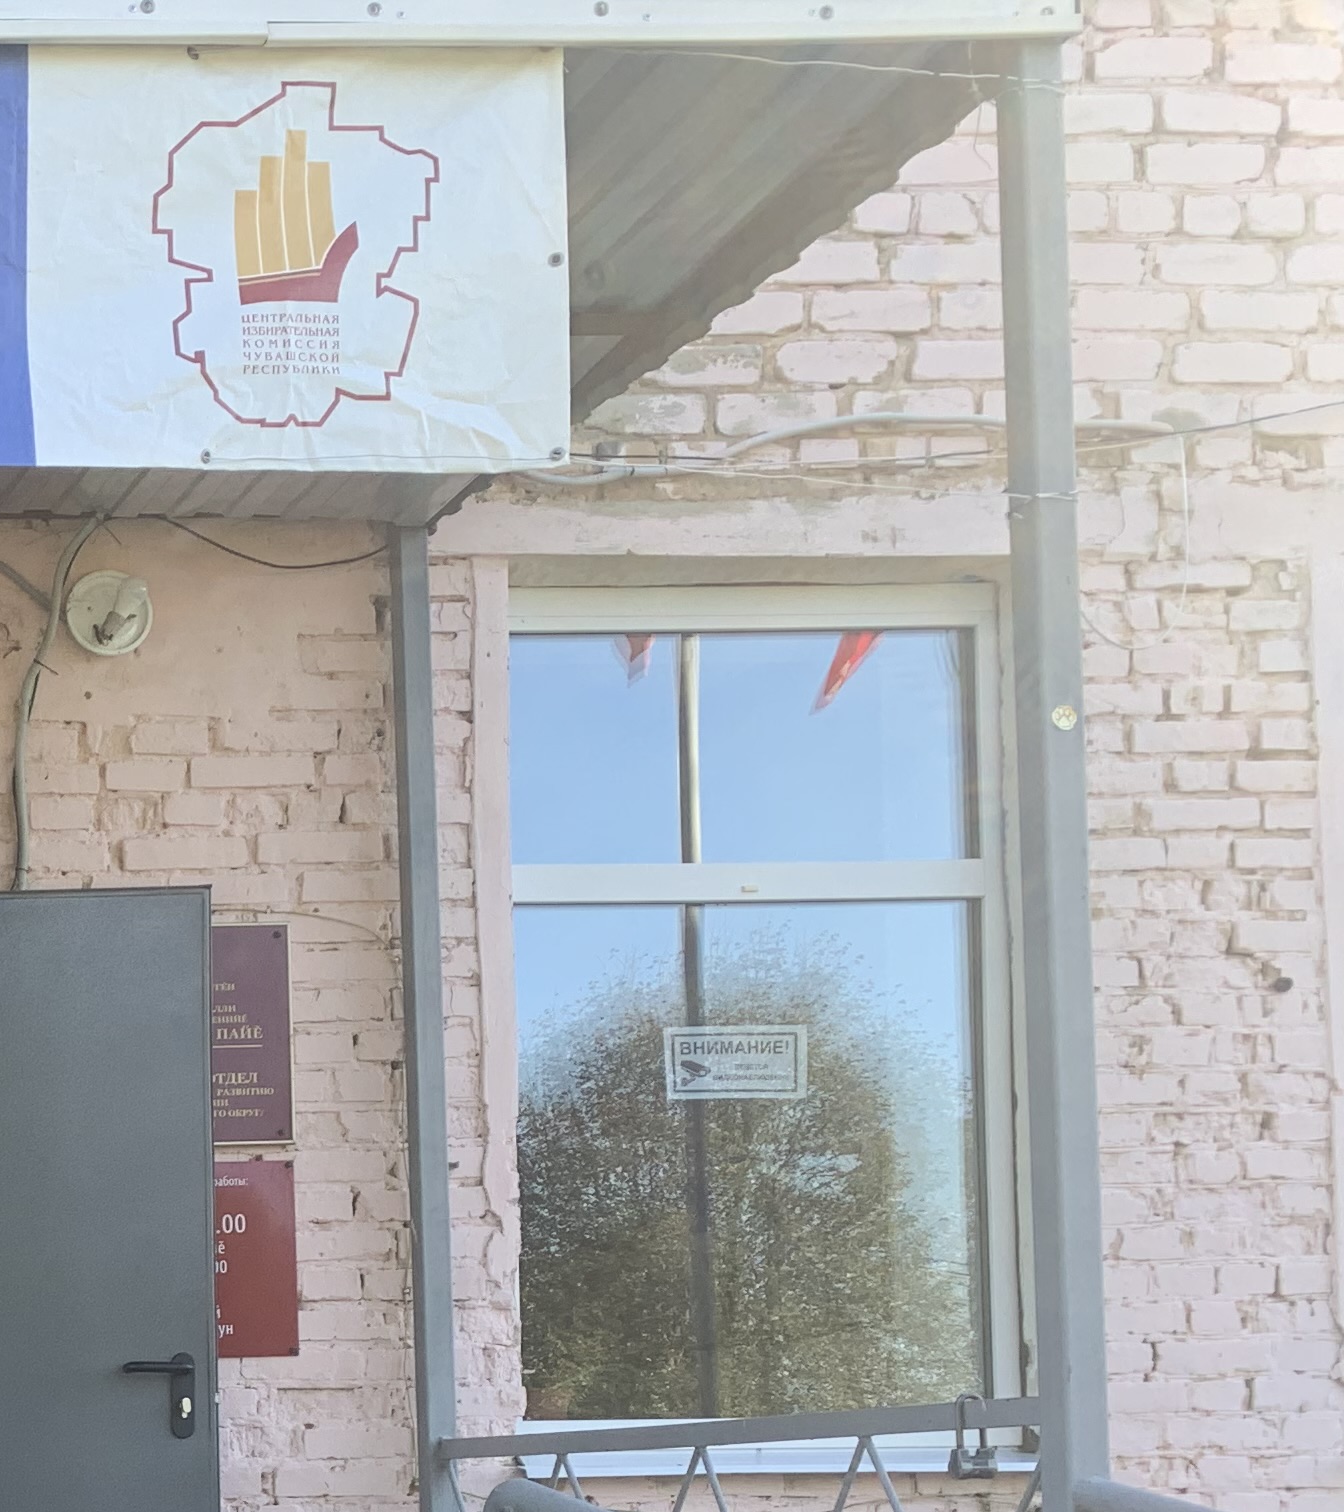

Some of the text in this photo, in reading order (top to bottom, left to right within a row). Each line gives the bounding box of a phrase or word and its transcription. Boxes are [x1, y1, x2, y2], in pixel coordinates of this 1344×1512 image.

[241, 313, 340, 325] ЦЕНТРАЛЬНАЯ
[242, 326, 340, 337] ИЗБИРАТЕЛЬНАЯ
[243, 339, 340, 350] КОМИССИЯ
[243, 351, 340, 363] ЧУВАШСКОЙ
[243, 364, 341, 375] РЕСПУБЛИКИ
[680, 1040, 790, 1055] ВНИМАНИЕ!
[217, 1088, 275, 1097] РАЗВИТИЮ
